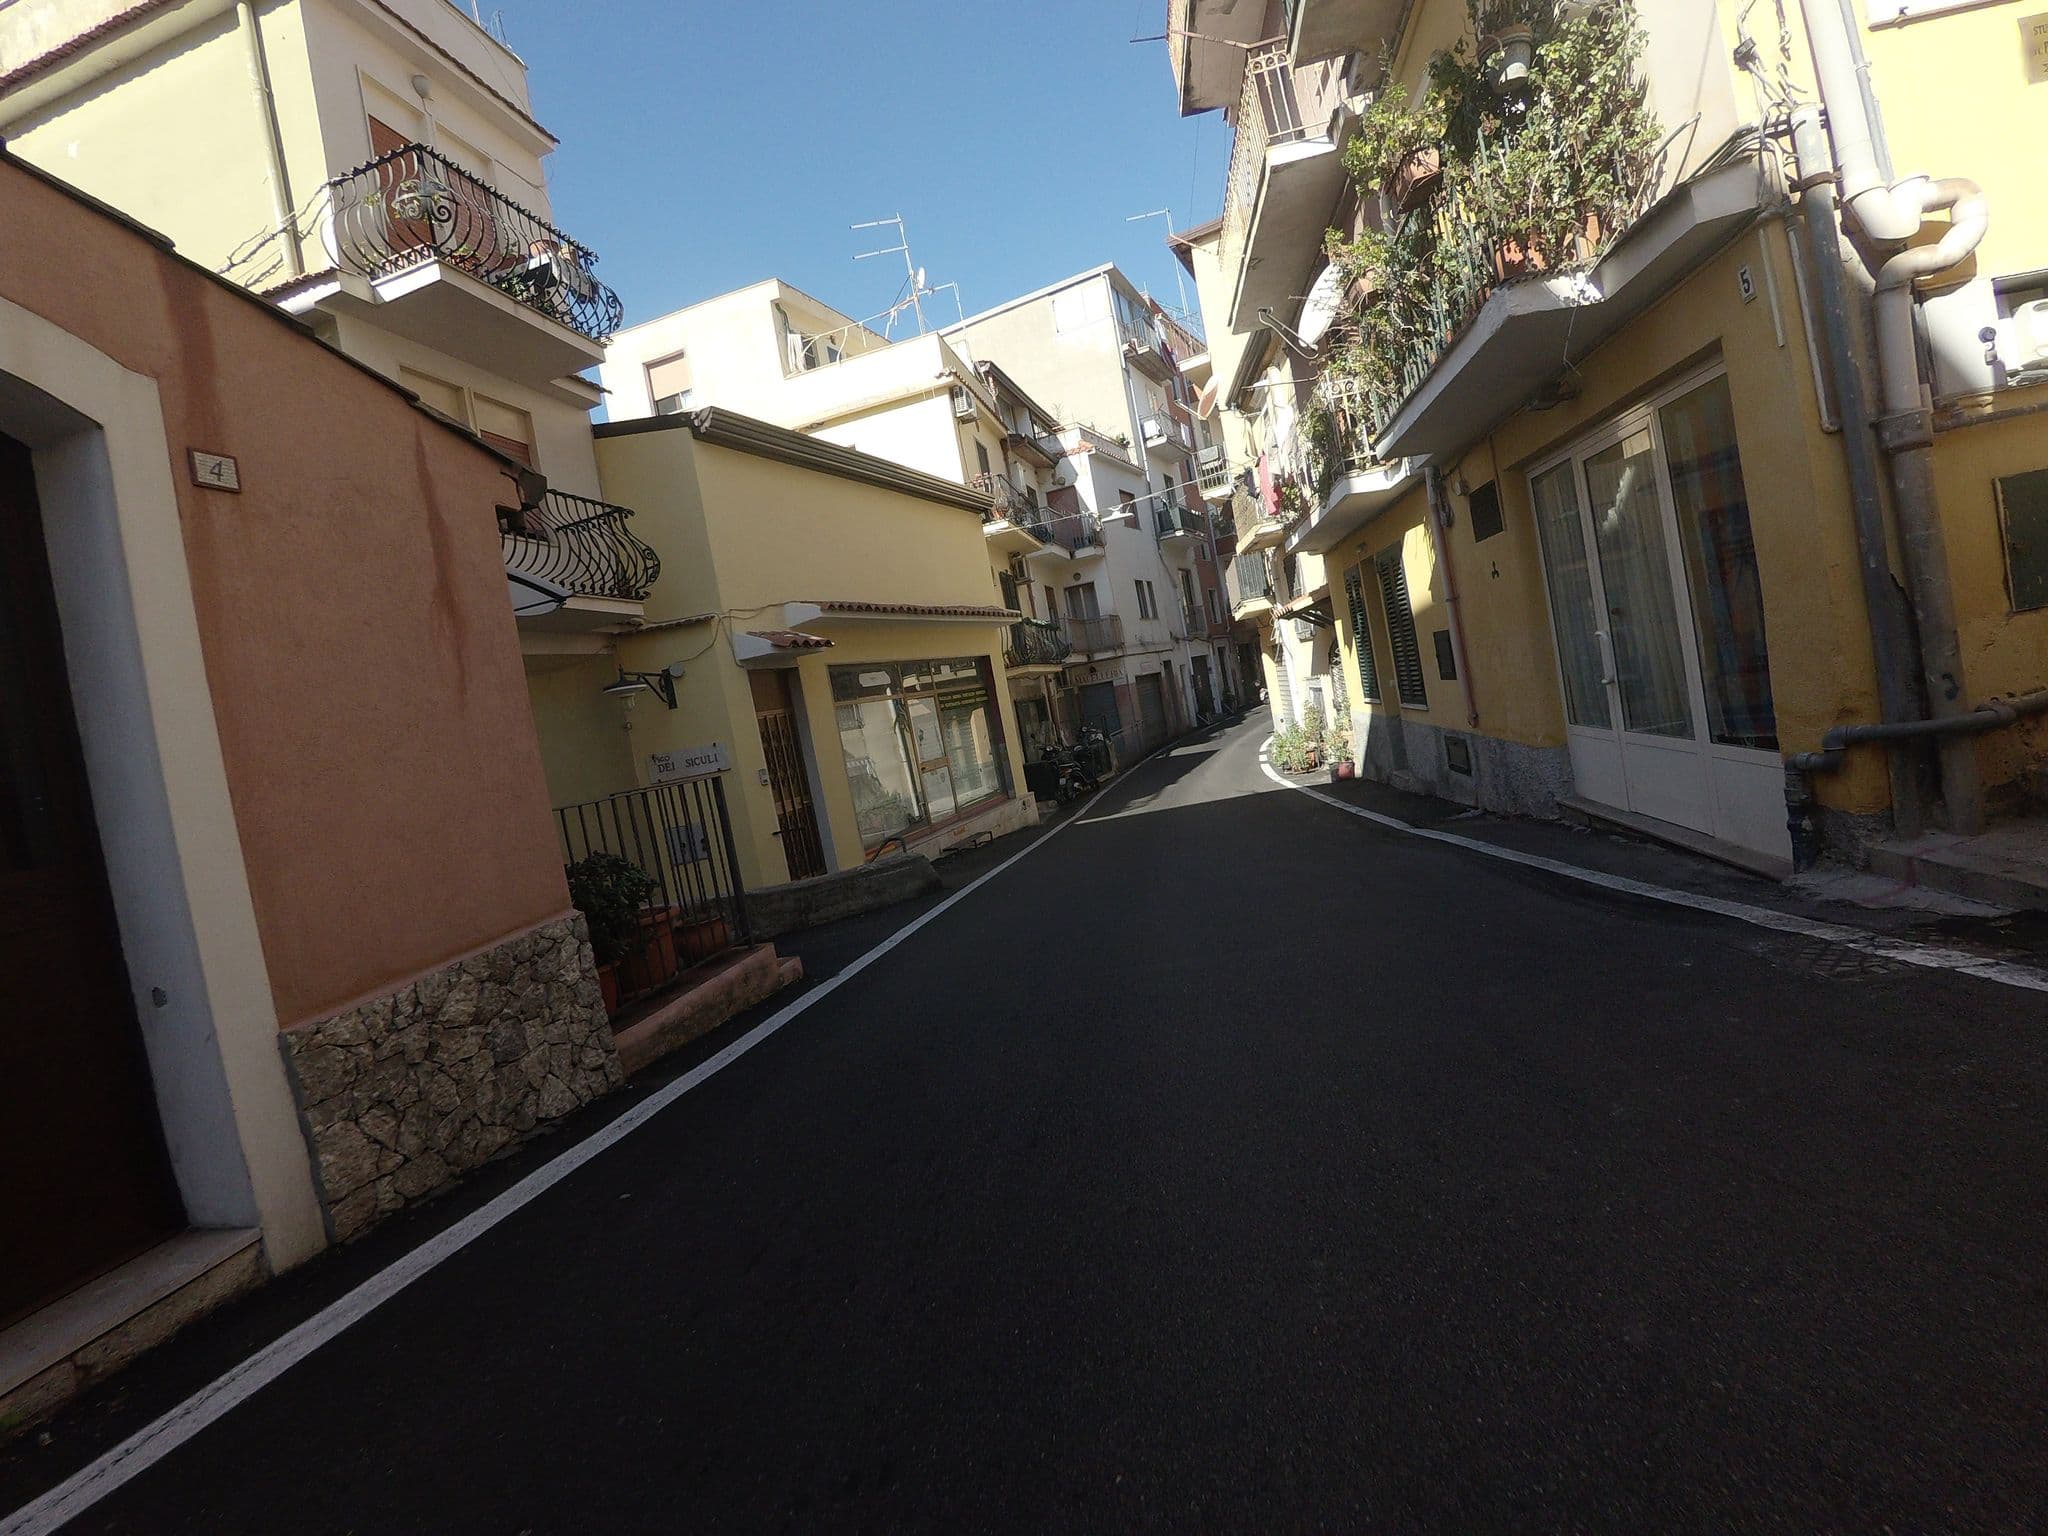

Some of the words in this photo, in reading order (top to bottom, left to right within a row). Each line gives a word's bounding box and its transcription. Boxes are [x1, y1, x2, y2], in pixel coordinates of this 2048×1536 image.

[1740, 268, 1750, 294] 5
[209, 460, 224, 482] 4
[658, 761, 676, 773] DEI
[684, 753, 719, 768] SICULI
